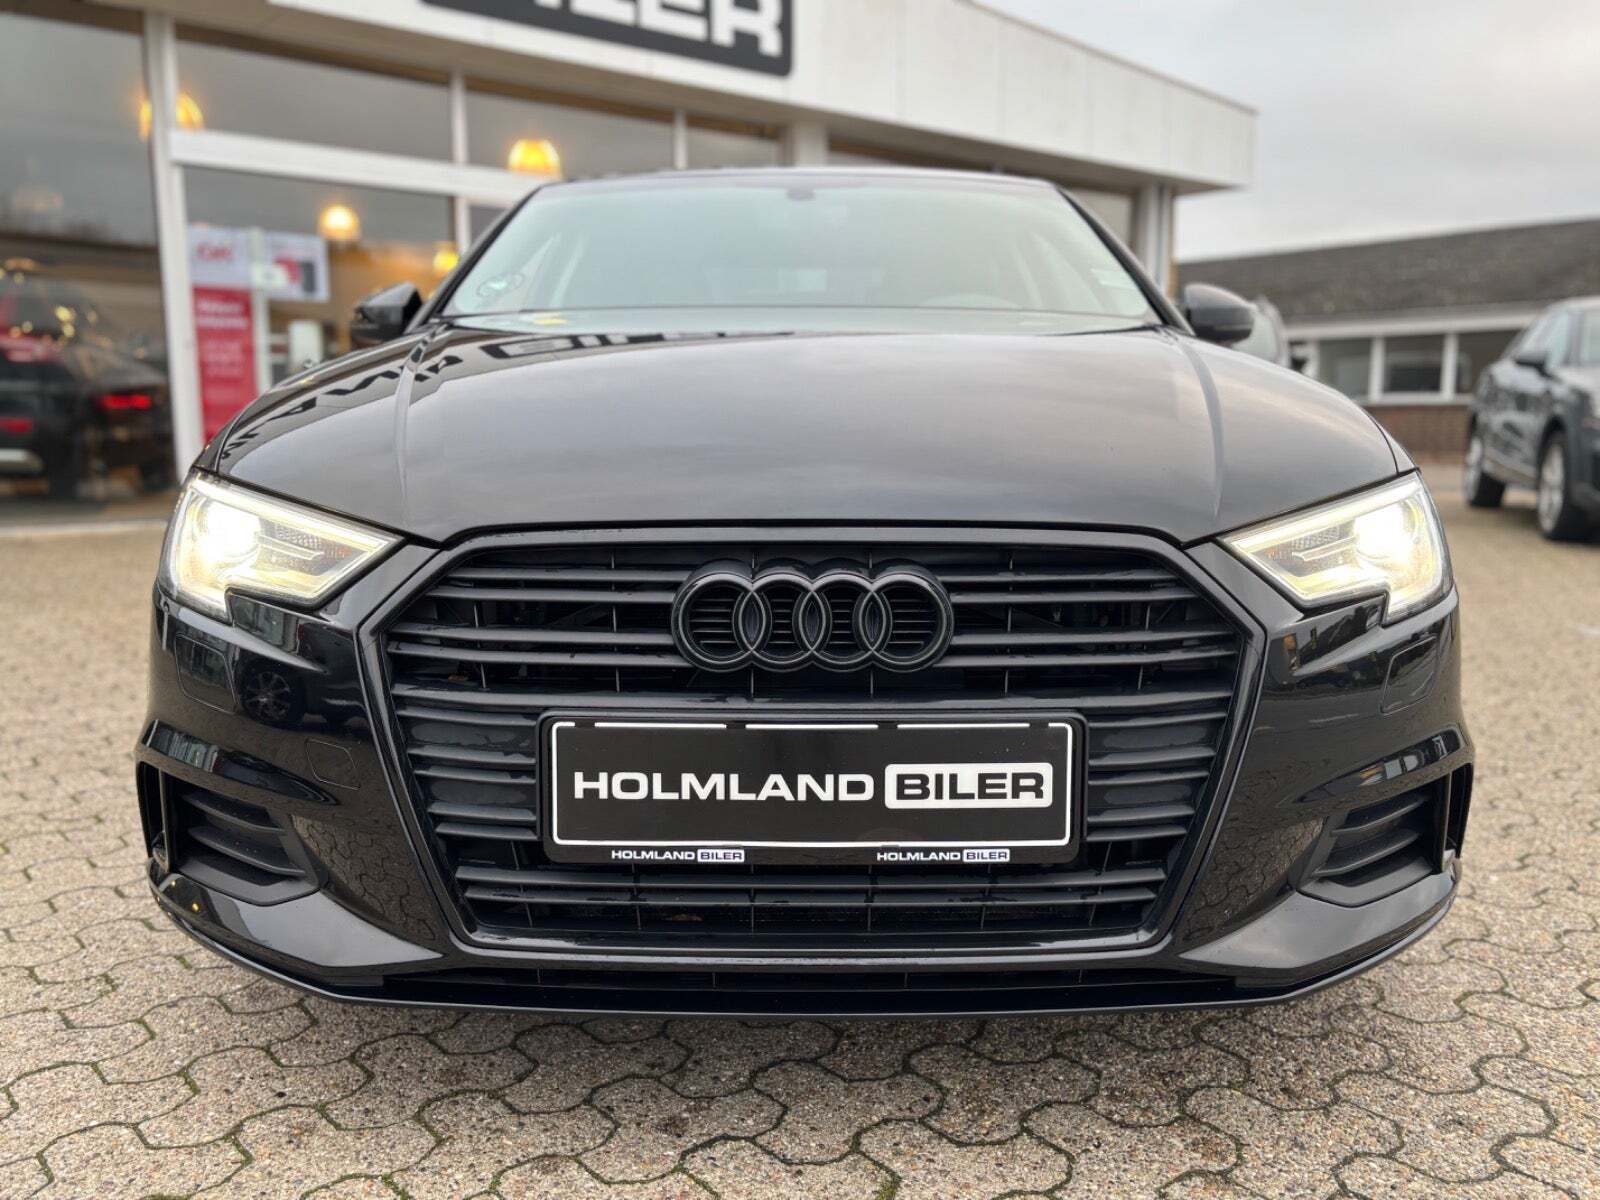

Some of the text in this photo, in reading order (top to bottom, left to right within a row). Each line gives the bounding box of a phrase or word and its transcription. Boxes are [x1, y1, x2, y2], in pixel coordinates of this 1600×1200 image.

[574, 771, 1044, 802] HOLMLAND BILER
[611, 850, 743, 861] HOLMLAND BILER
[876, 851, 1008, 862] HOLMLAND BILER
